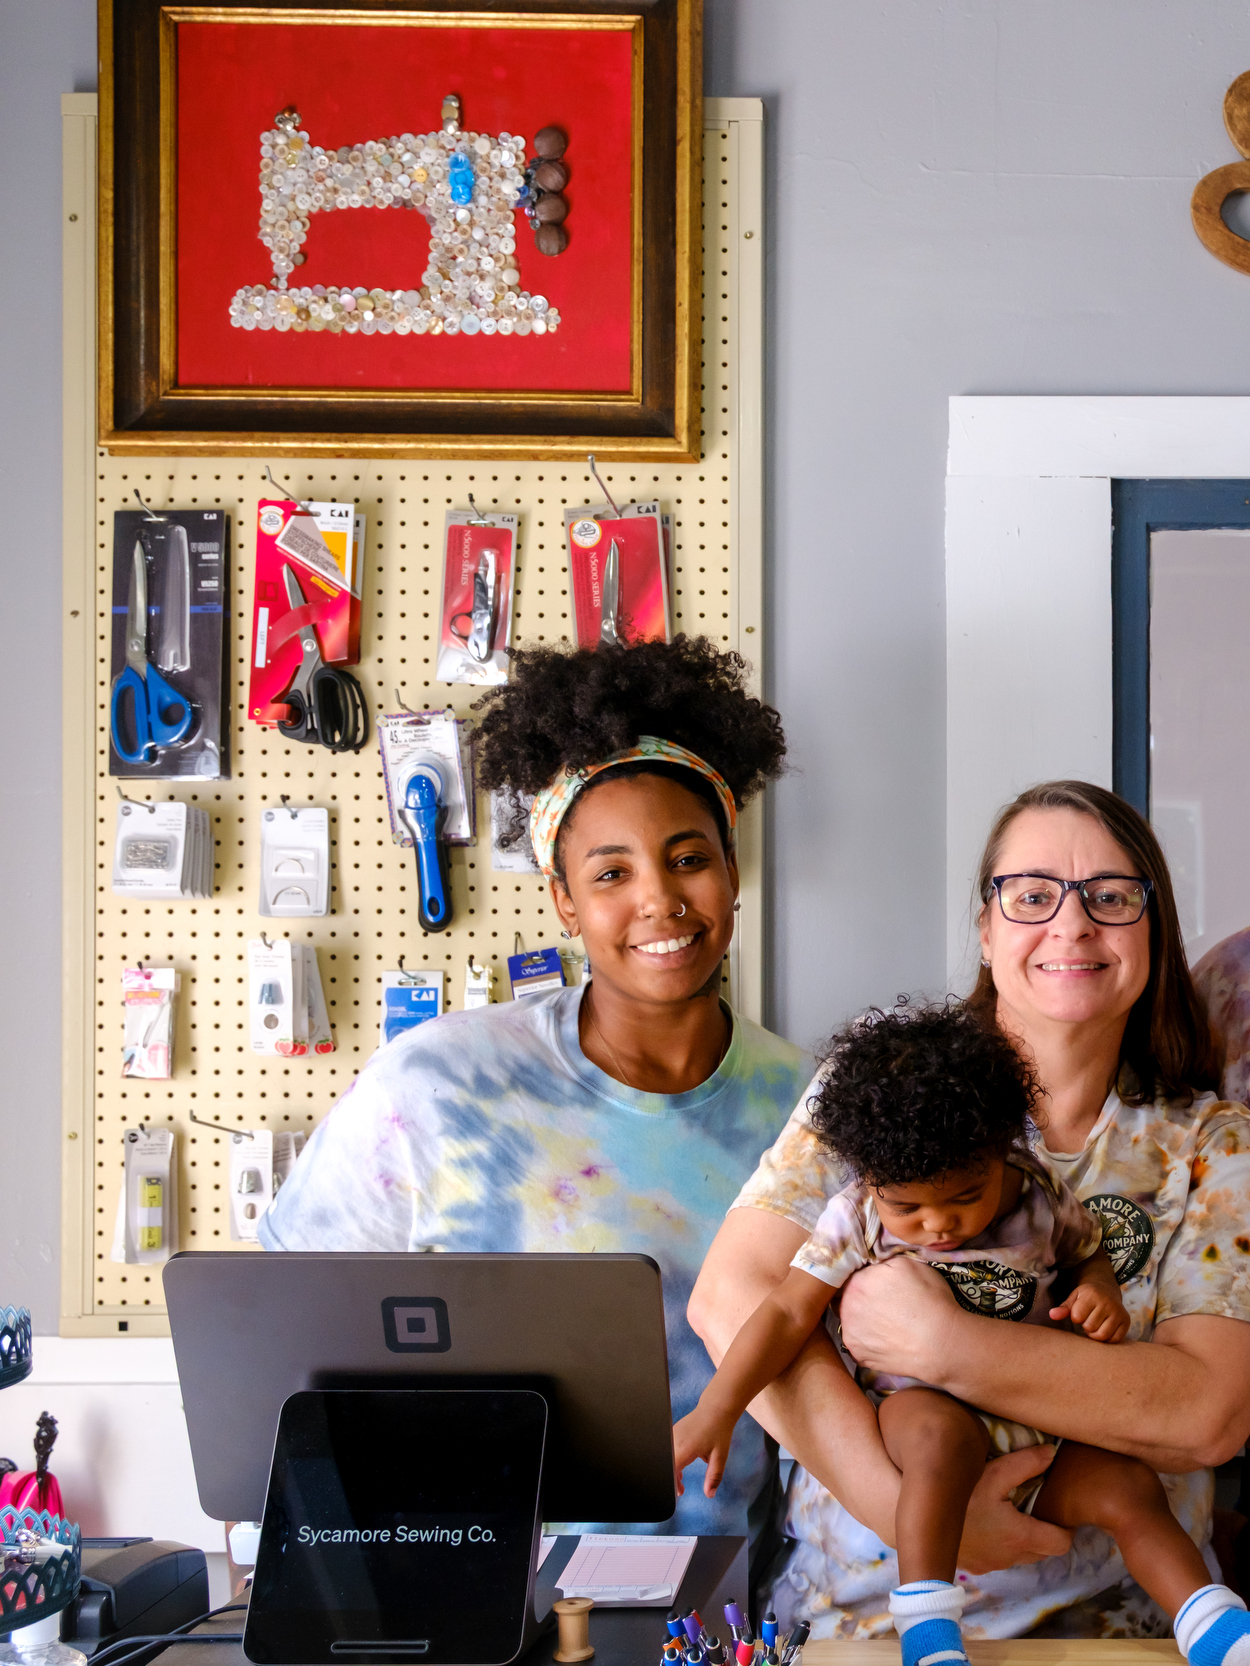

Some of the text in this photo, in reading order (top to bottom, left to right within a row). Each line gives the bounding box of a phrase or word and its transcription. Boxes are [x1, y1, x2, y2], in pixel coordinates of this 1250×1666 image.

[203, 511, 217, 520] KAI
[330, 509, 349, 518] KAI
[637, 505, 657, 514] KAI
[461, 530, 472, 586] N5000 SERIES
[590, 552, 601, 607] N5000 SERIES
[390, 730, 398, 744] 45
[521, 965, 549, 976] Superior
[411, 990, 435, 1001] KAI
[1088, 1198, 1141, 1222] AMORE
[999, 1303, 1024, 1319] NOTIONS
[297, 1525, 497, 1546] Sycamore Sewing Co.
